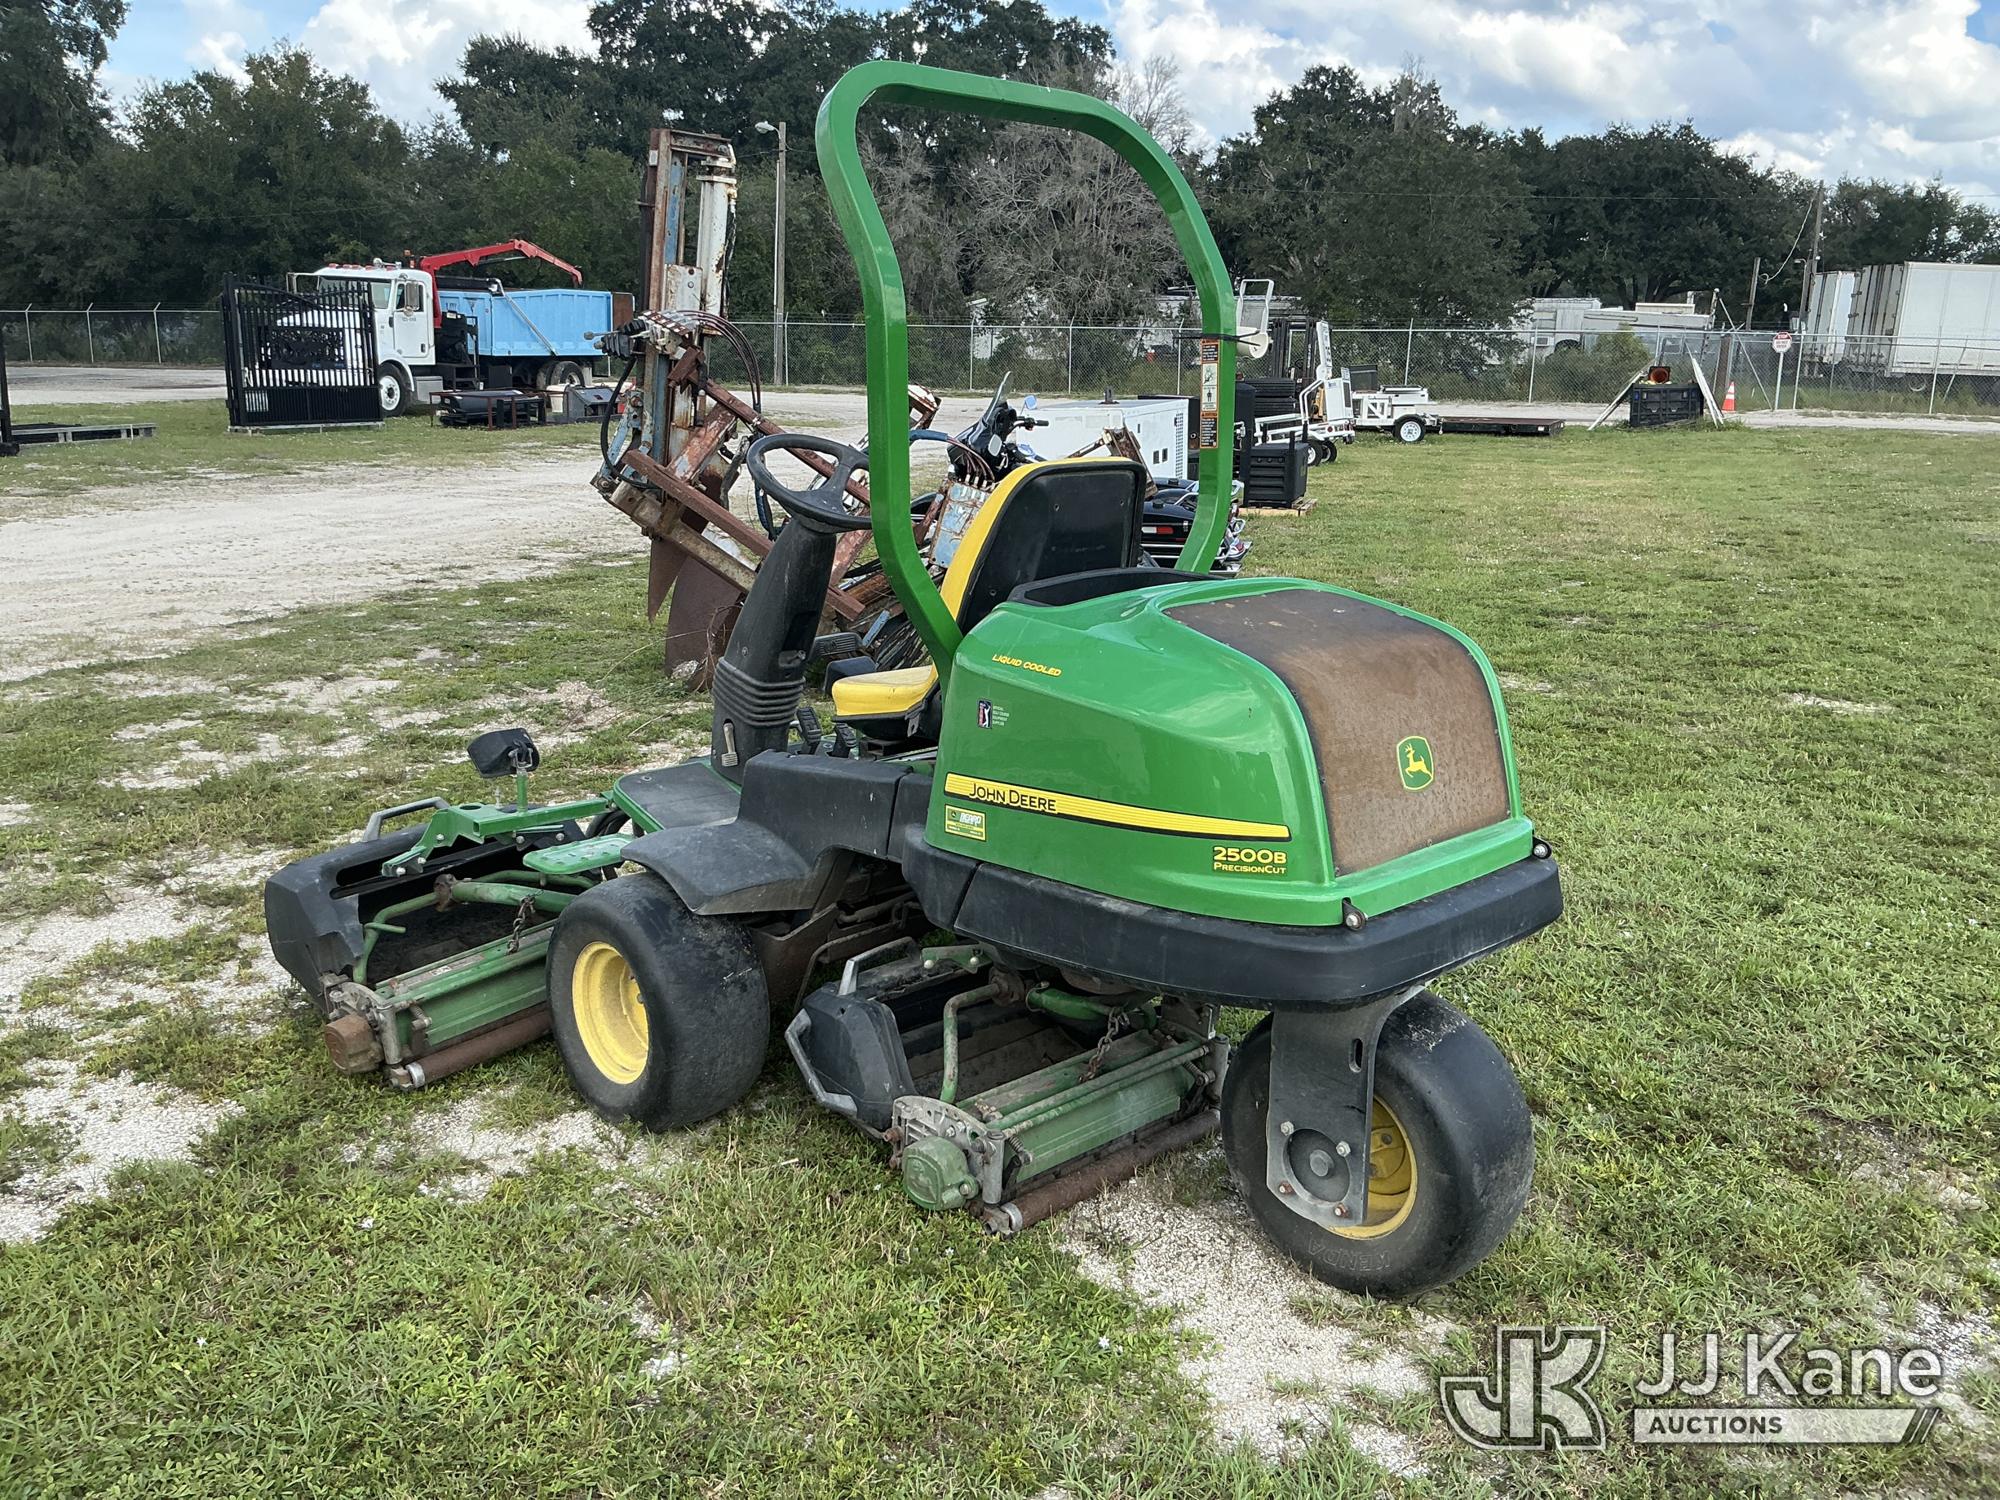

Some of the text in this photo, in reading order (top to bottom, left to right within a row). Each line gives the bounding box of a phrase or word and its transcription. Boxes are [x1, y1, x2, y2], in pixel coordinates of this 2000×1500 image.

[992, 654, 1062, 677] LIQUID COOLED
[969, 783, 1057, 812] JOHN DEERE
[1213, 846, 1287, 864] 2500B
[1306, 1239, 1392, 1272] KENDA
